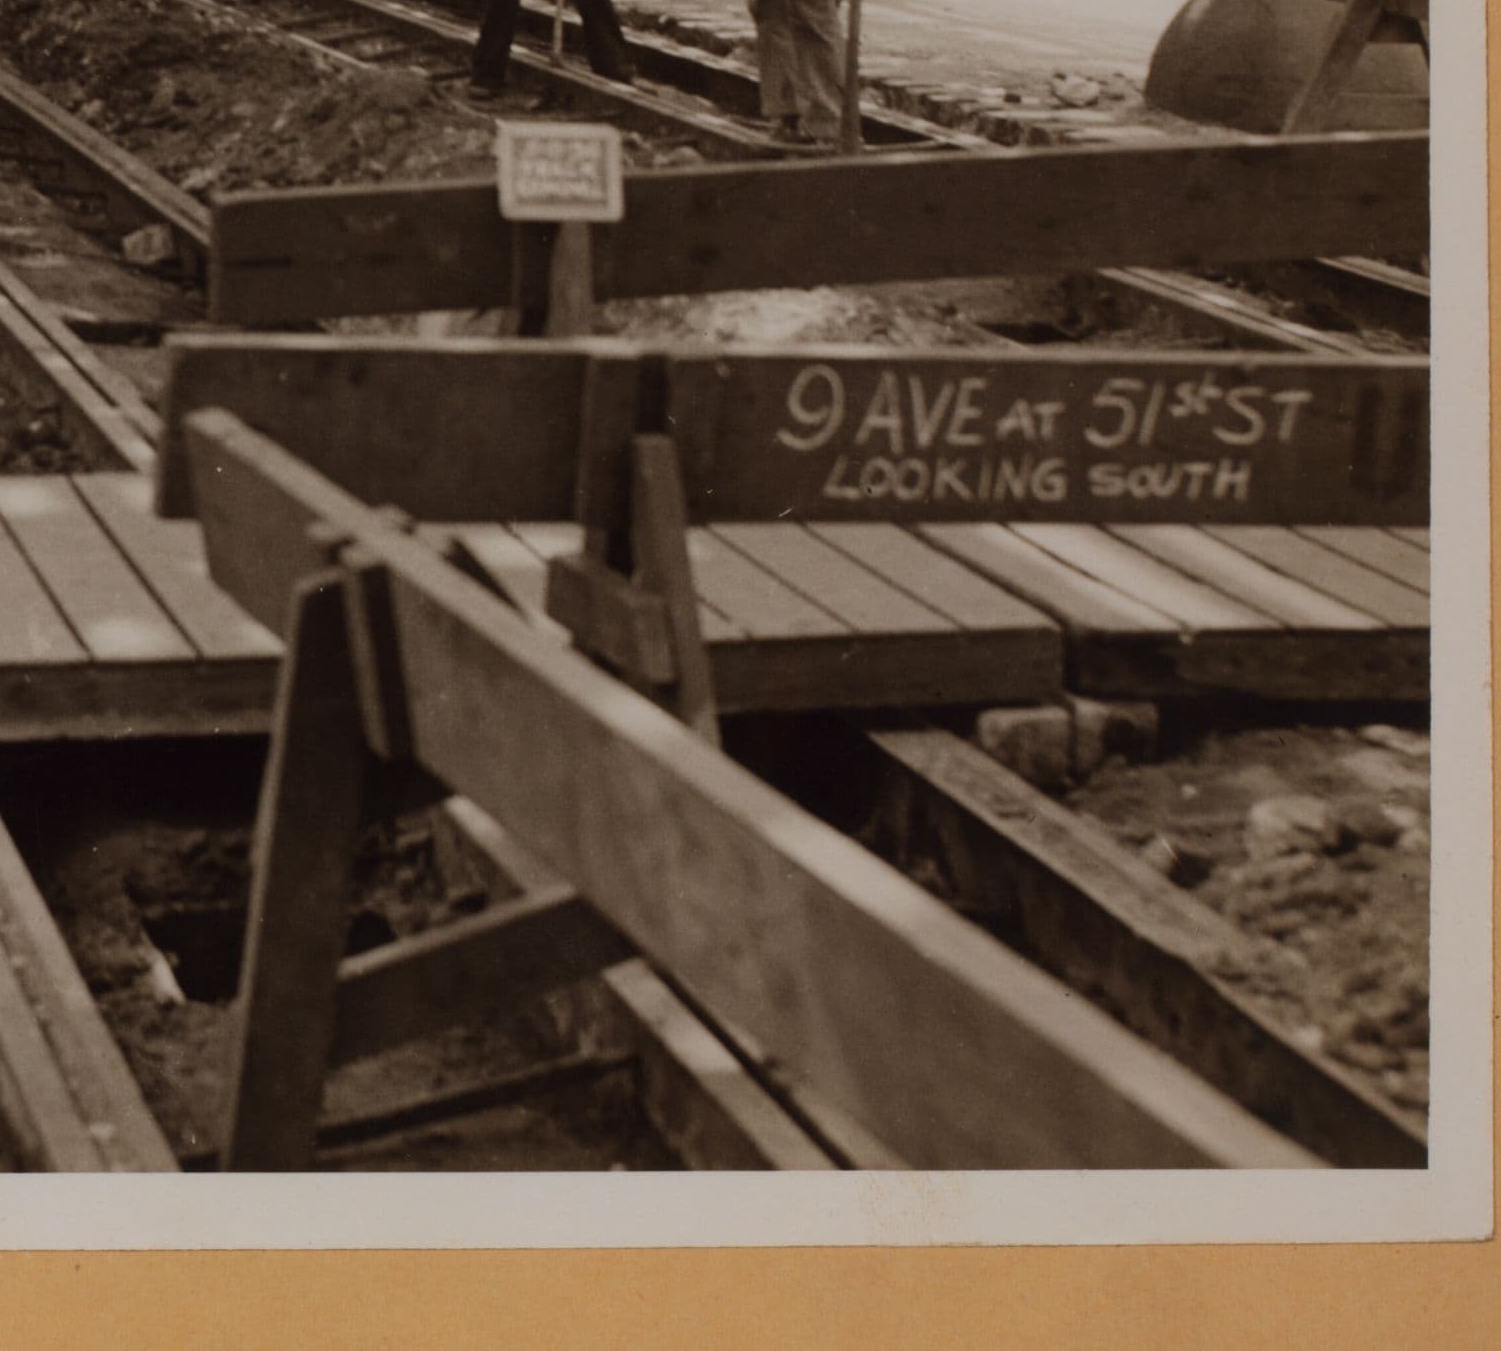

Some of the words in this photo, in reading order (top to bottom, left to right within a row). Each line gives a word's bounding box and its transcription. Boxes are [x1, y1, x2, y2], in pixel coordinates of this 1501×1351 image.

[776, 363, 846, 450] 9
[855, 371, 988, 451] AVE
[999, 399, 1067, 440] AT
[1212, 386, 1314, 446] ST
[823, 456, 1068, 502] LOOKING
[1088, 458, 1253, 502] SOUTH
